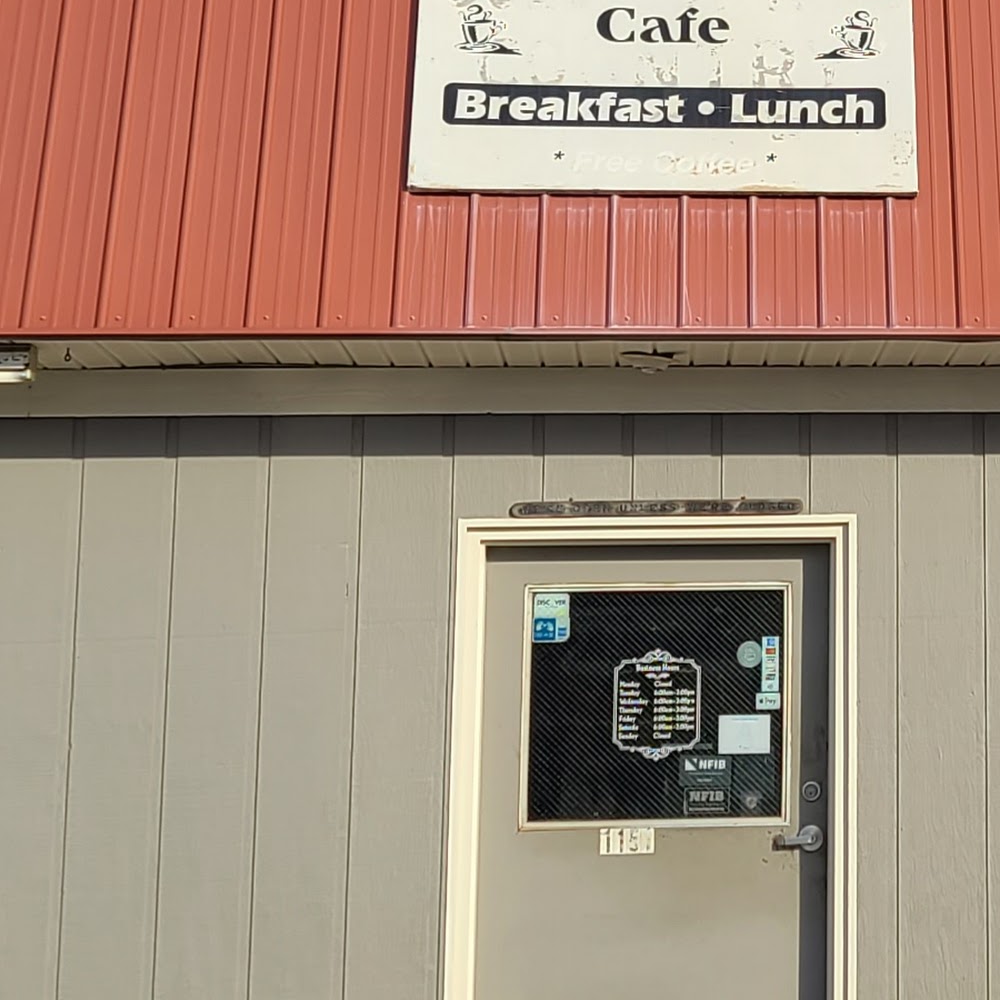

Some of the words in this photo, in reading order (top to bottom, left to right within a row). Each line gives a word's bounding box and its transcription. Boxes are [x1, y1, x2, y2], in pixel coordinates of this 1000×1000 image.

[596, 7, 730, 45] Cafe
[453, 88, 686, 123] Breakfast
[730, 93, 875, 125] Lunch
[698, 759, 726, 770] NFIB
[688, 791, 725, 802] NFIB
